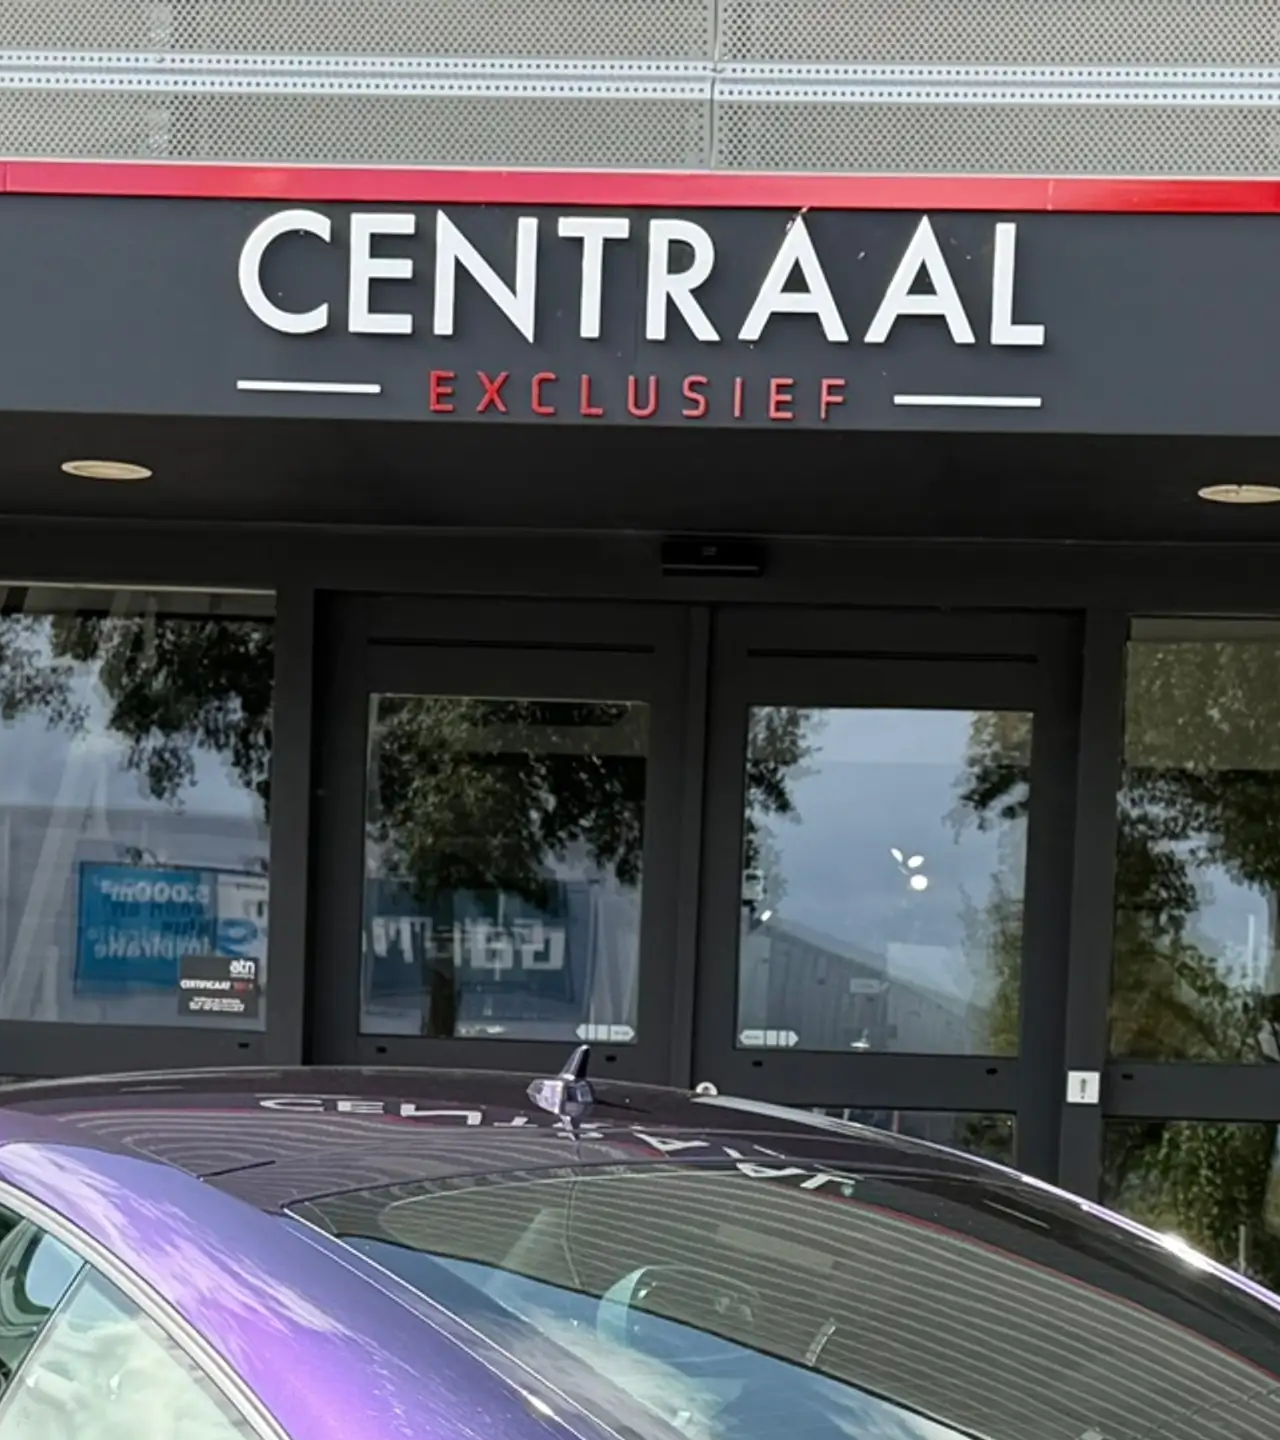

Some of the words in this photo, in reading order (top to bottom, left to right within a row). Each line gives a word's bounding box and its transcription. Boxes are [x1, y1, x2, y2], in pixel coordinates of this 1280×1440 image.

[238, 209, 1045, 346] CENTRAAL
[428, 370, 848, 421] EXCLUSIEF
[229, 958, 256, 974] atn
